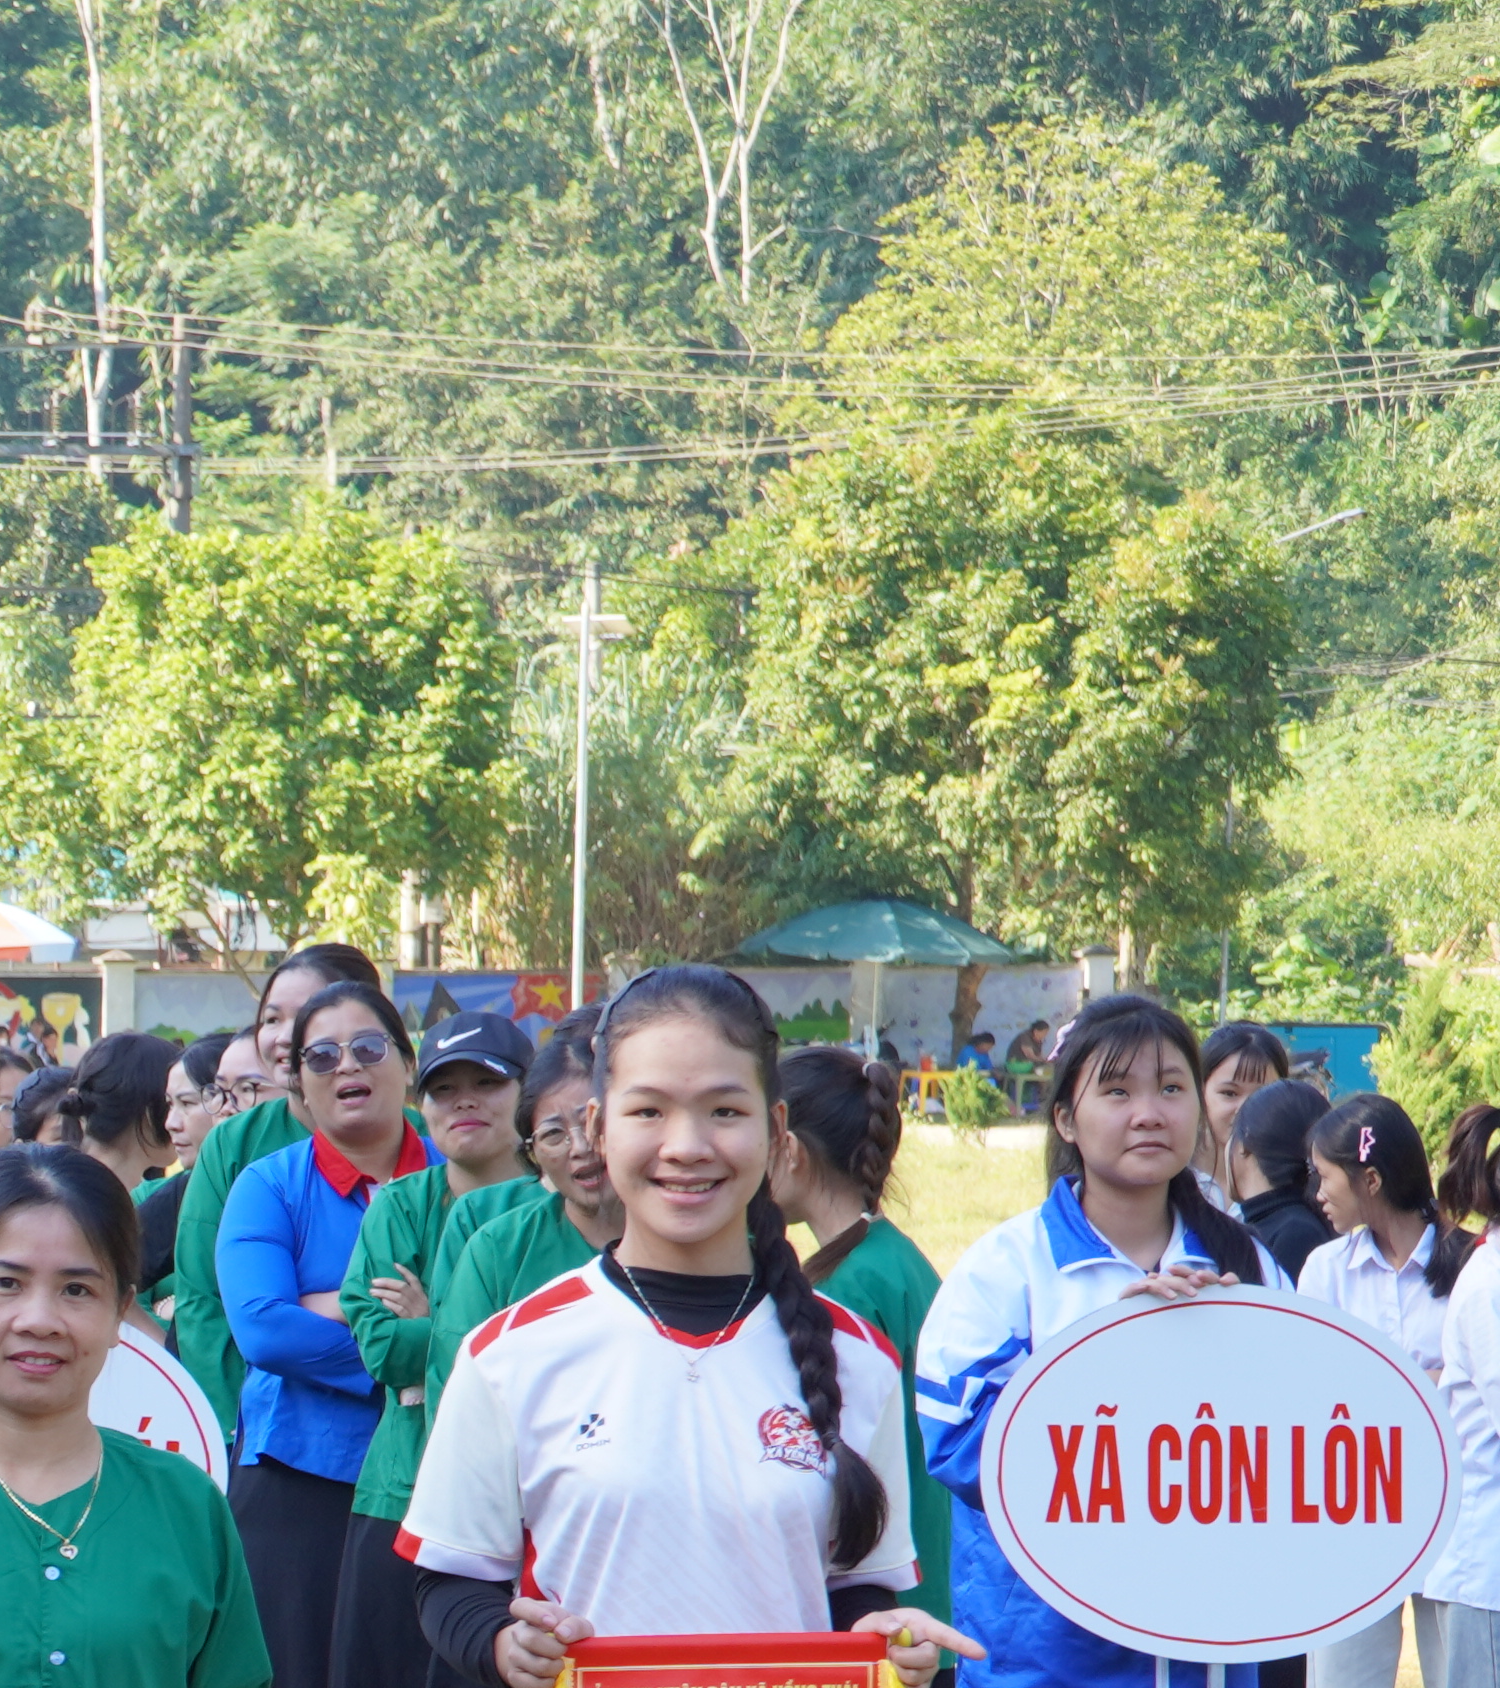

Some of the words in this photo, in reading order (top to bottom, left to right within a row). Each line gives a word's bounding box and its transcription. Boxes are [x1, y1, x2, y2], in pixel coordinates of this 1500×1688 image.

[1045, 1403, 1125, 1524] XÃ
[1147, 1402, 1269, 1525] CÔN
[1291, 1403, 1402, 1525] LÔN
